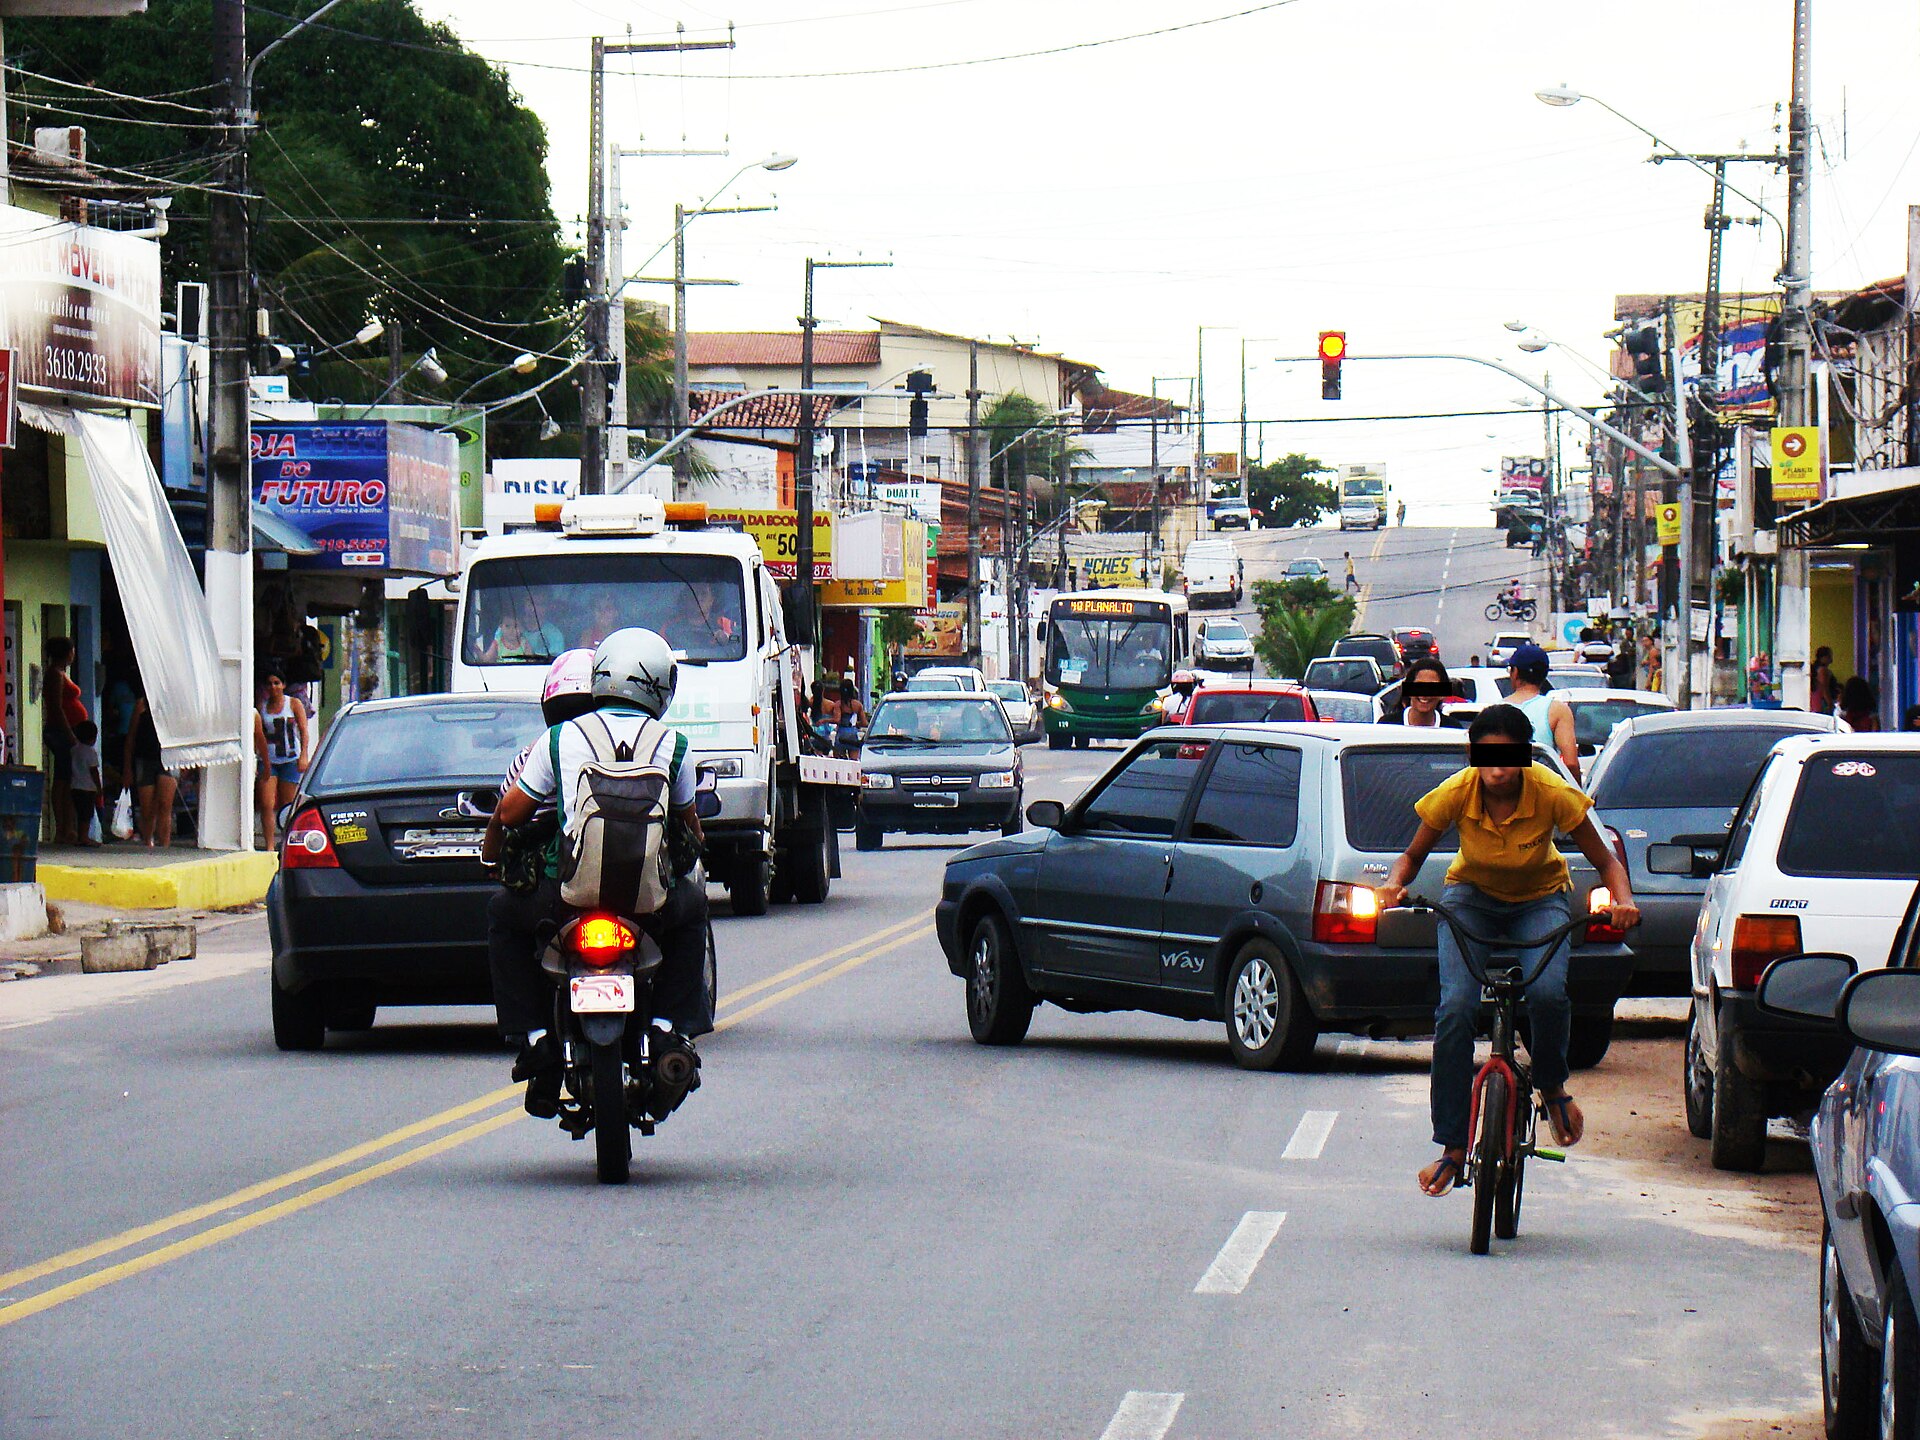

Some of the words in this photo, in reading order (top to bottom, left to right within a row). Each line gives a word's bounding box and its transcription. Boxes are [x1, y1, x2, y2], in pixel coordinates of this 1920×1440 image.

[45, 345, 107, 386] 3618.2933
[251, 433, 297, 459] OJA
[280, 461, 311, 478] DO
[259, 479, 386, 507] FUTURO
[748, 514, 765, 526] DA
[766, 514, 831, 527] ECONMIA
[1085, 601, 1133, 613] PLANALTO
[331, 811, 368, 820] FIESTA
[1769, 899, 1809, 909] FIAT
